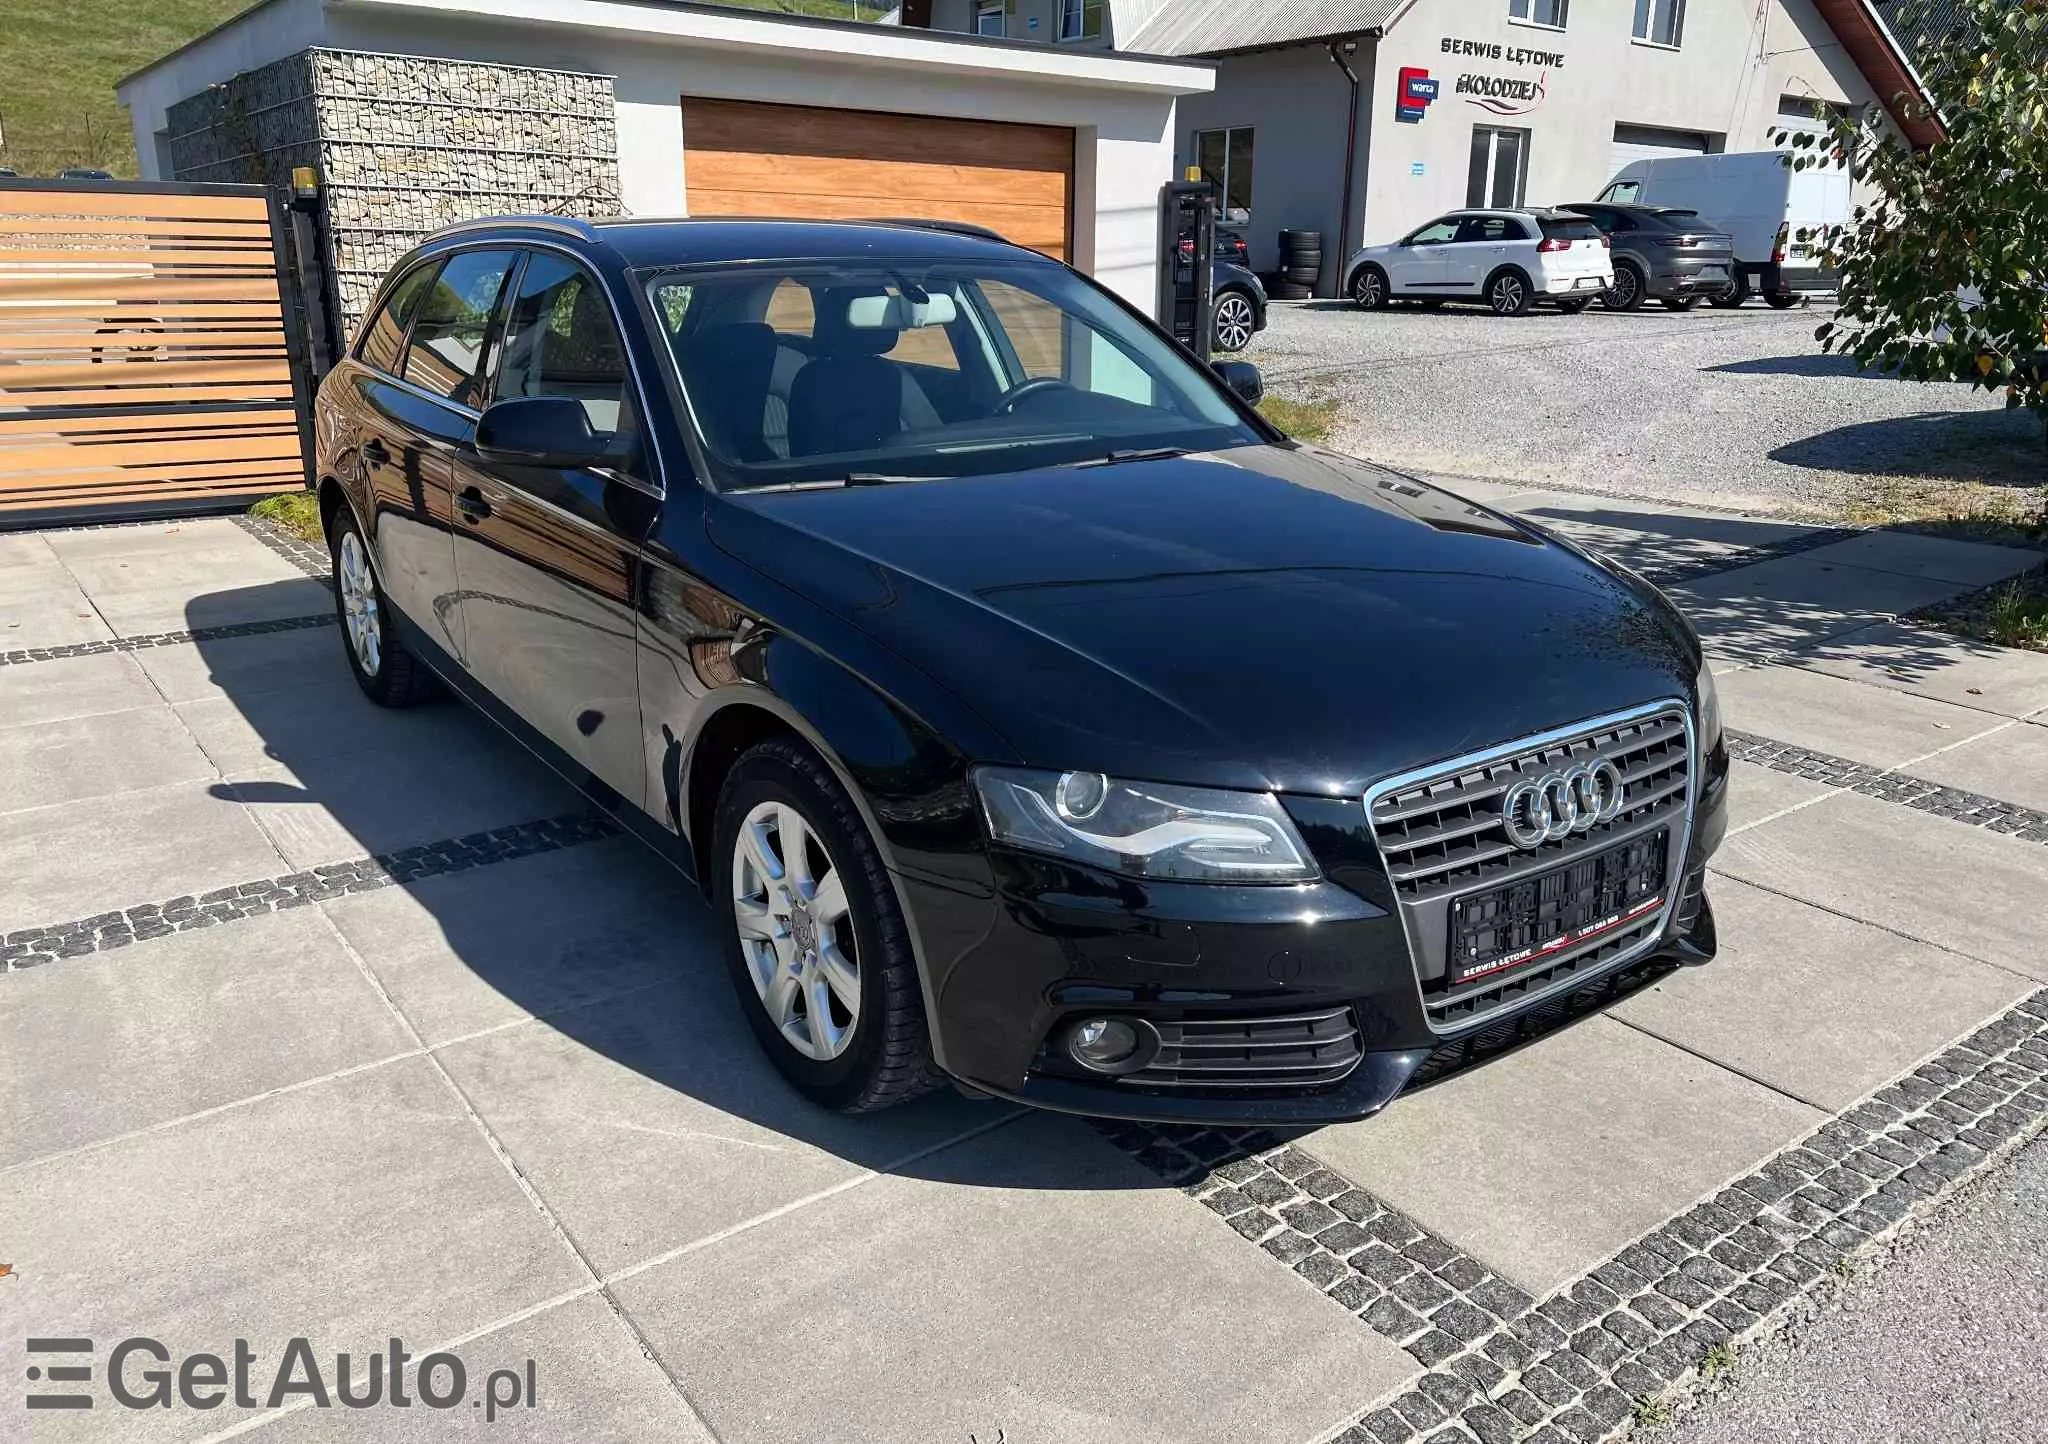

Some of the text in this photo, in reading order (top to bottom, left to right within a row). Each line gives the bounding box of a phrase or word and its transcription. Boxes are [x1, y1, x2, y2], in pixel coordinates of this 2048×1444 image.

[1441, 38, 1565, 68] SERWIS ŁĘTOWE
[1463, 960, 1497, 977] SERWIS
